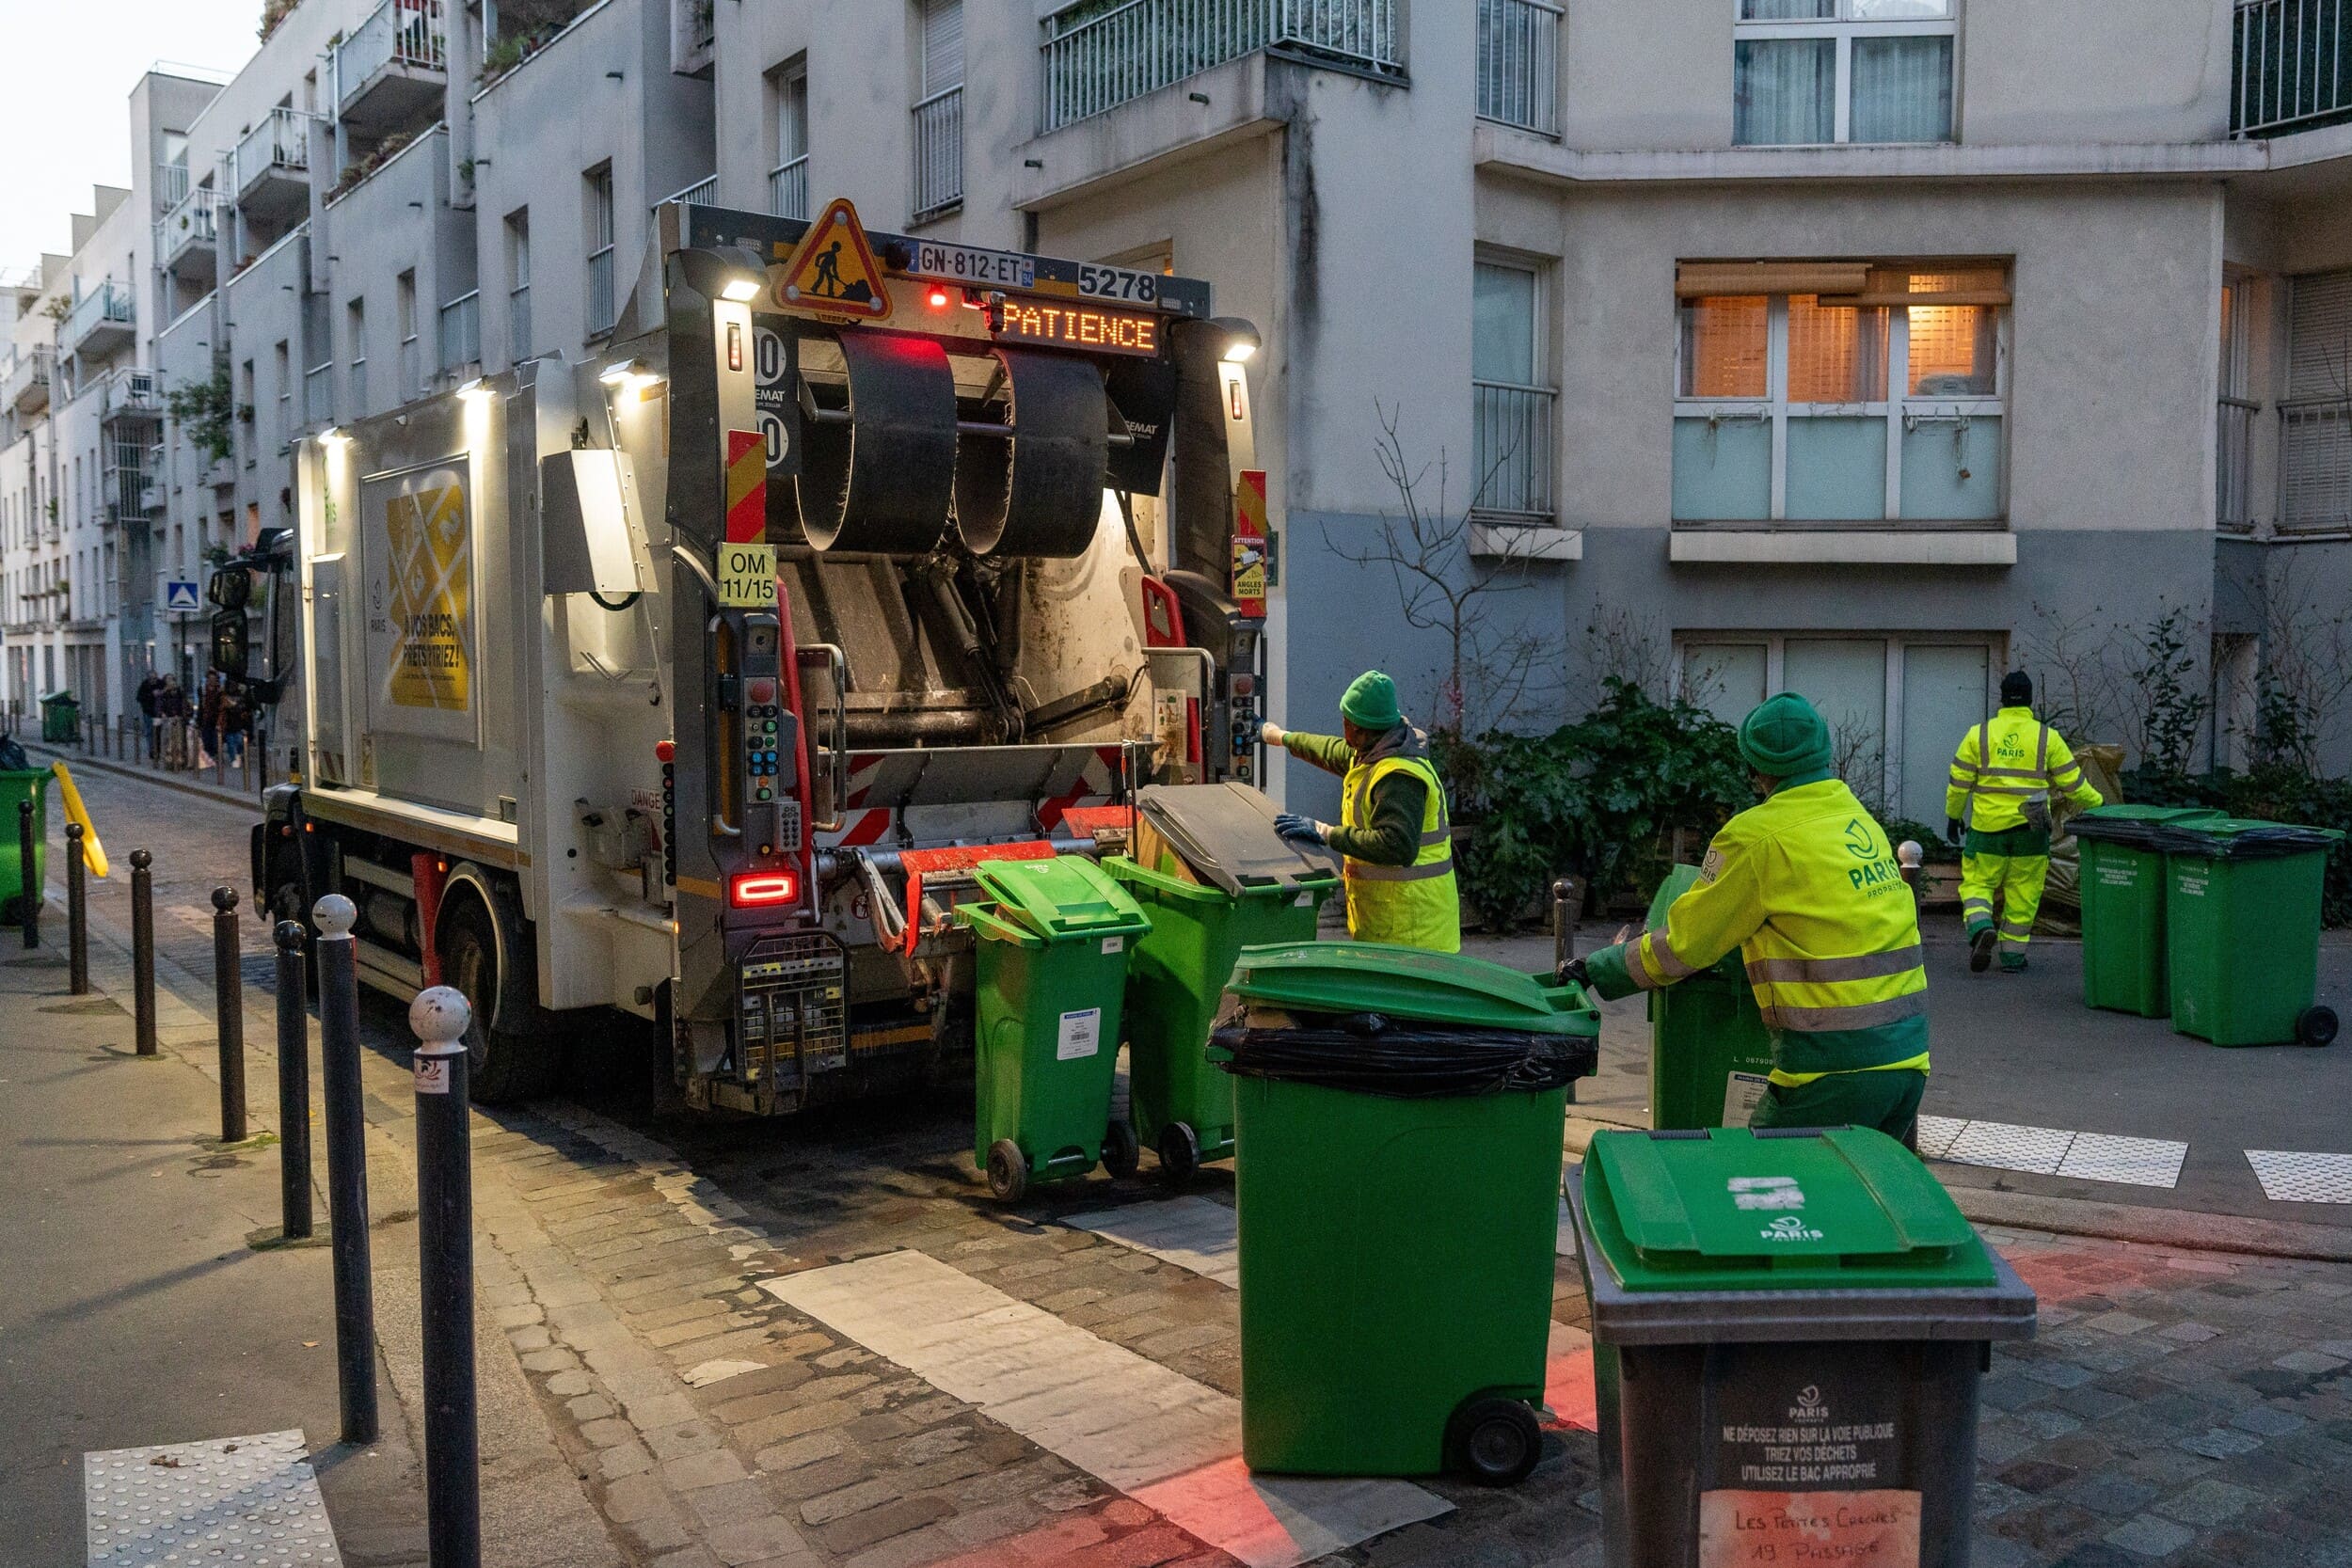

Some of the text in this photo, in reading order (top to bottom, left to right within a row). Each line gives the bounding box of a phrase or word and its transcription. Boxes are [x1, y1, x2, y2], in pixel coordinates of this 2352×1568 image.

[922, 247, 1020, 282] GN-812-ET
[1078, 266, 1155, 302] 5278
[1002, 303, 1154, 349] PATIENCE
[753, 333, 779, 379] 0
[755, 389, 785, 402] EMAT
[731, 553, 765, 574] OM
[723, 578, 773, 599] 11/15
[1996, 748, 2026, 758] PARIS
[631, 790, 660, 809] DANGE
[1848, 859, 1899, 890] PARIS
[1760, 1229, 1823, 1239] PARIS
[1788, 1406, 1829, 1418] PARIS
[1724, 1422, 1894, 1443] NE DÉPOSEZ RIEN SUR LA VOIE PUBLIQUE
[1764, 1443, 1857, 1462] TRIEZ VOS DÉCHETS
[1741, 1461, 1876, 1481] UTILISEZ LE BAC APPROPRIÉ
[1752, 1543, 1776, 1561] 19
